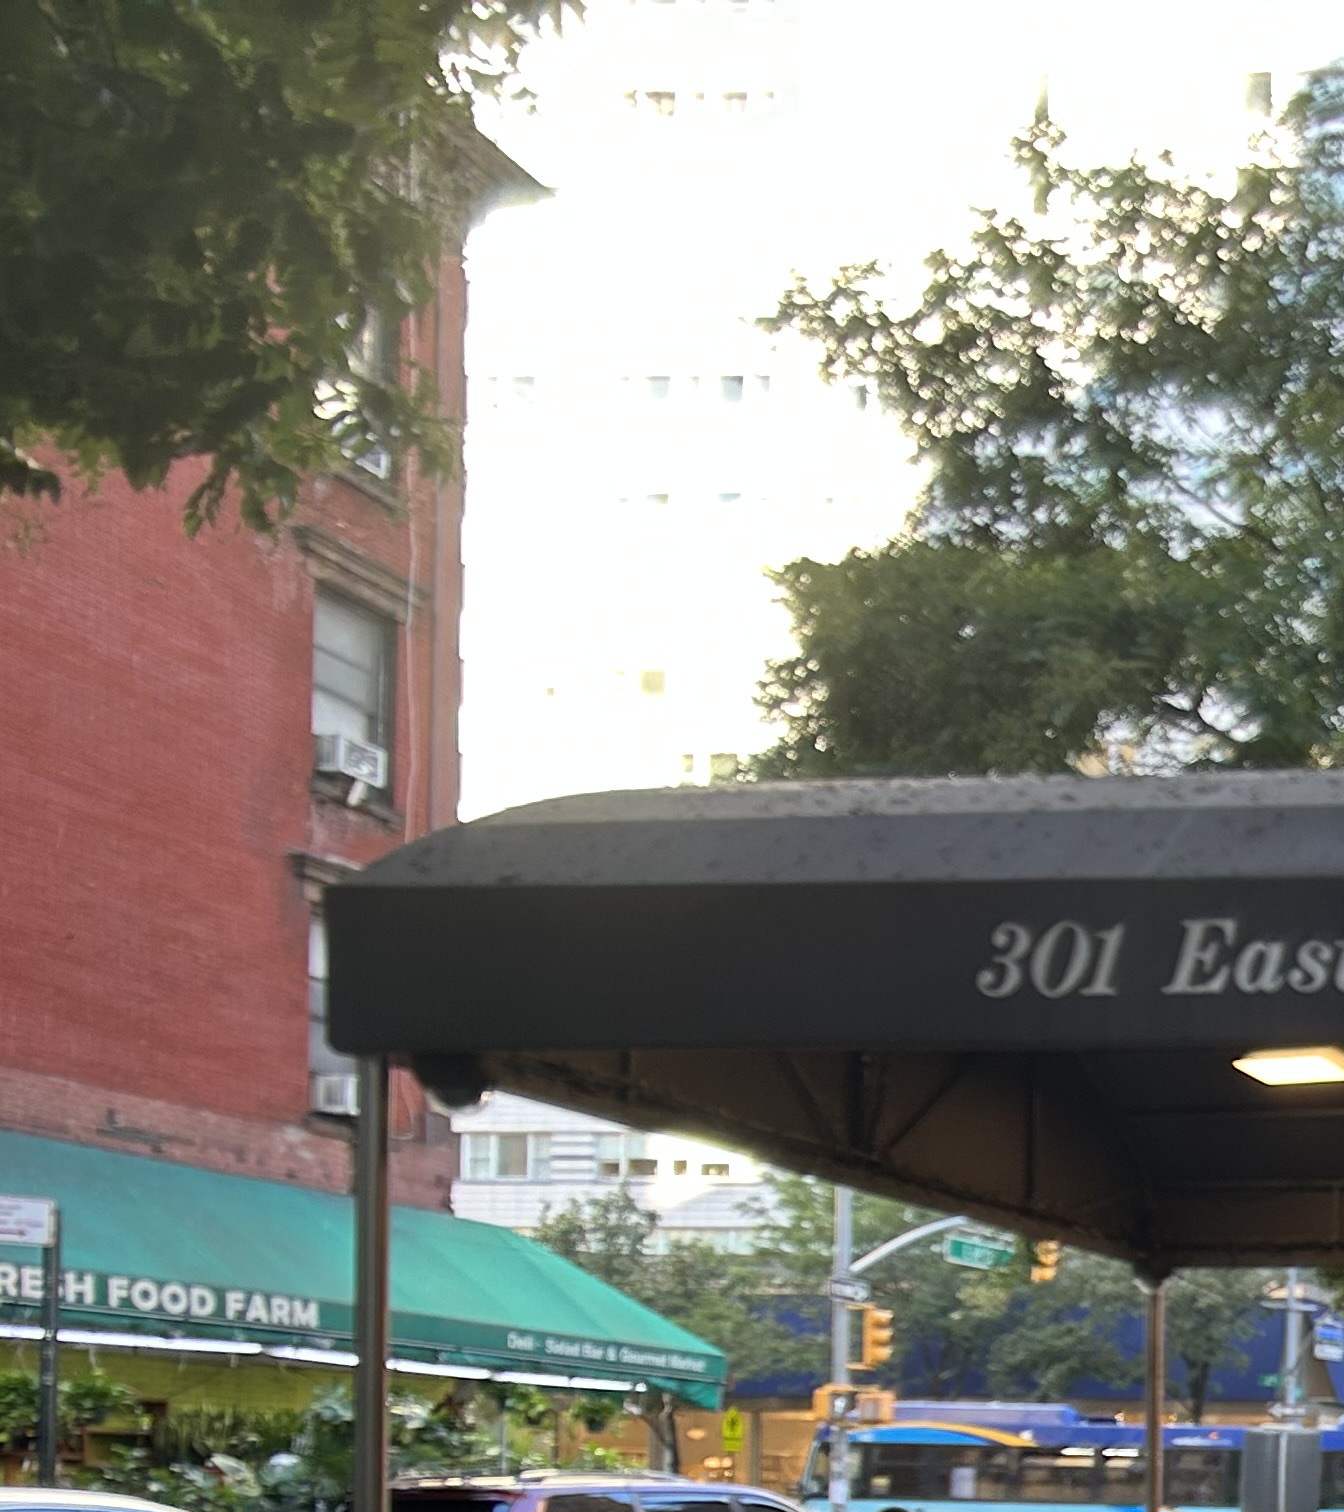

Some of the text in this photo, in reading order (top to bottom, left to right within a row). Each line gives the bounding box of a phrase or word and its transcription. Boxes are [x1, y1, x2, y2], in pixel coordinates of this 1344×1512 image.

[975, 919, 1126, 999] 301
[0, 1262, 320, 1329] REH FOOD FARM
